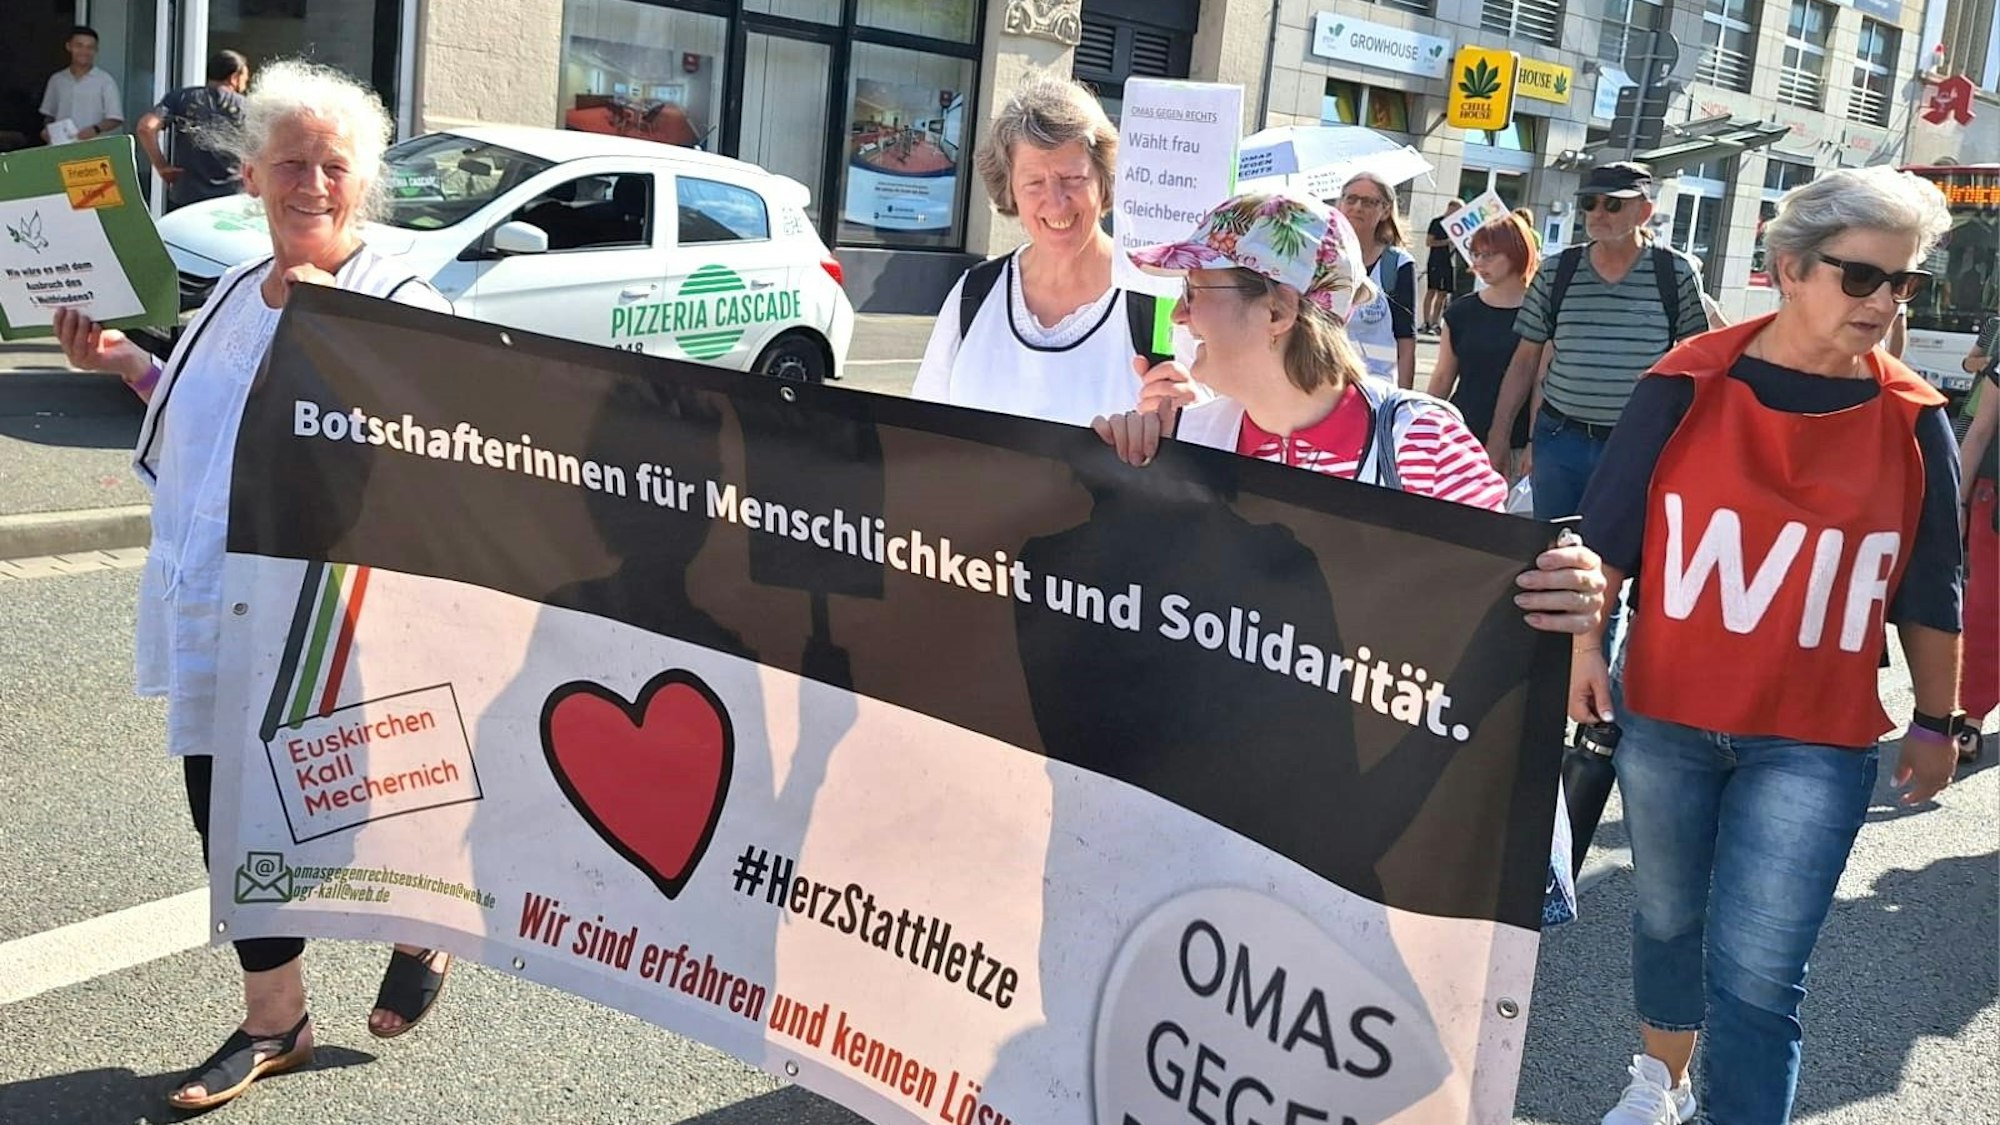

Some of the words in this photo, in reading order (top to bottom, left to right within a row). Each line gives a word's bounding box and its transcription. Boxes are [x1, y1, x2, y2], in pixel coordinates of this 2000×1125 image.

[1350, 33, 1419, 60] GROWHOUSE
[1518, 68, 1552, 89] HOUSE
[1131, 106, 1154, 117] OMAS
[1155, 108, 1183, 120] GEGEN
[1185, 110, 1218, 123] RECHTS
[1459, 110, 1492, 120] HOUSE
[1460, 102, 1492, 111] CHILL
[1129, 132, 1168, 151] Wählt
[1172, 135, 1200, 154] frau
[1125, 165, 1154, 184] AfD,
[1158, 169, 1198, 189] dann:
[1451, 199, 1499, 237] OMAS
[611, 299, 708, 338] PIZZERIA
[714, 290, 801, 327] CASCADE
[293, 399, 627, 497] Botschafterinnen
[635, 462, 695, 511] für
[705, 480, 1032, 602] Menschlichkeit
[1045, 574, 1143, 632] und
[1158, 593, 1470, 742] Solidarität.
[288, 711, 436, 764] Euskirchen
[296, 753, 354, 791] Kall
[303, 759, 459, 816] Mechernich
[292, 882, 391, 903] ogr-kall@web.de
[293, 865, 496, 909] omasgegenrechtseuskirchen@web.de
[732, 845, 1020, 1010] #HerzStattHetze
[518, 892, 571, 943] Wir
[572, 915, 638, 971] sind
[640, 942, 767, 1023] erfahren
[768, 992, 830, 1048] und
[831, 1011, 944, 1108] kennen
[1179, 919, 1397, 1079] OMAS
